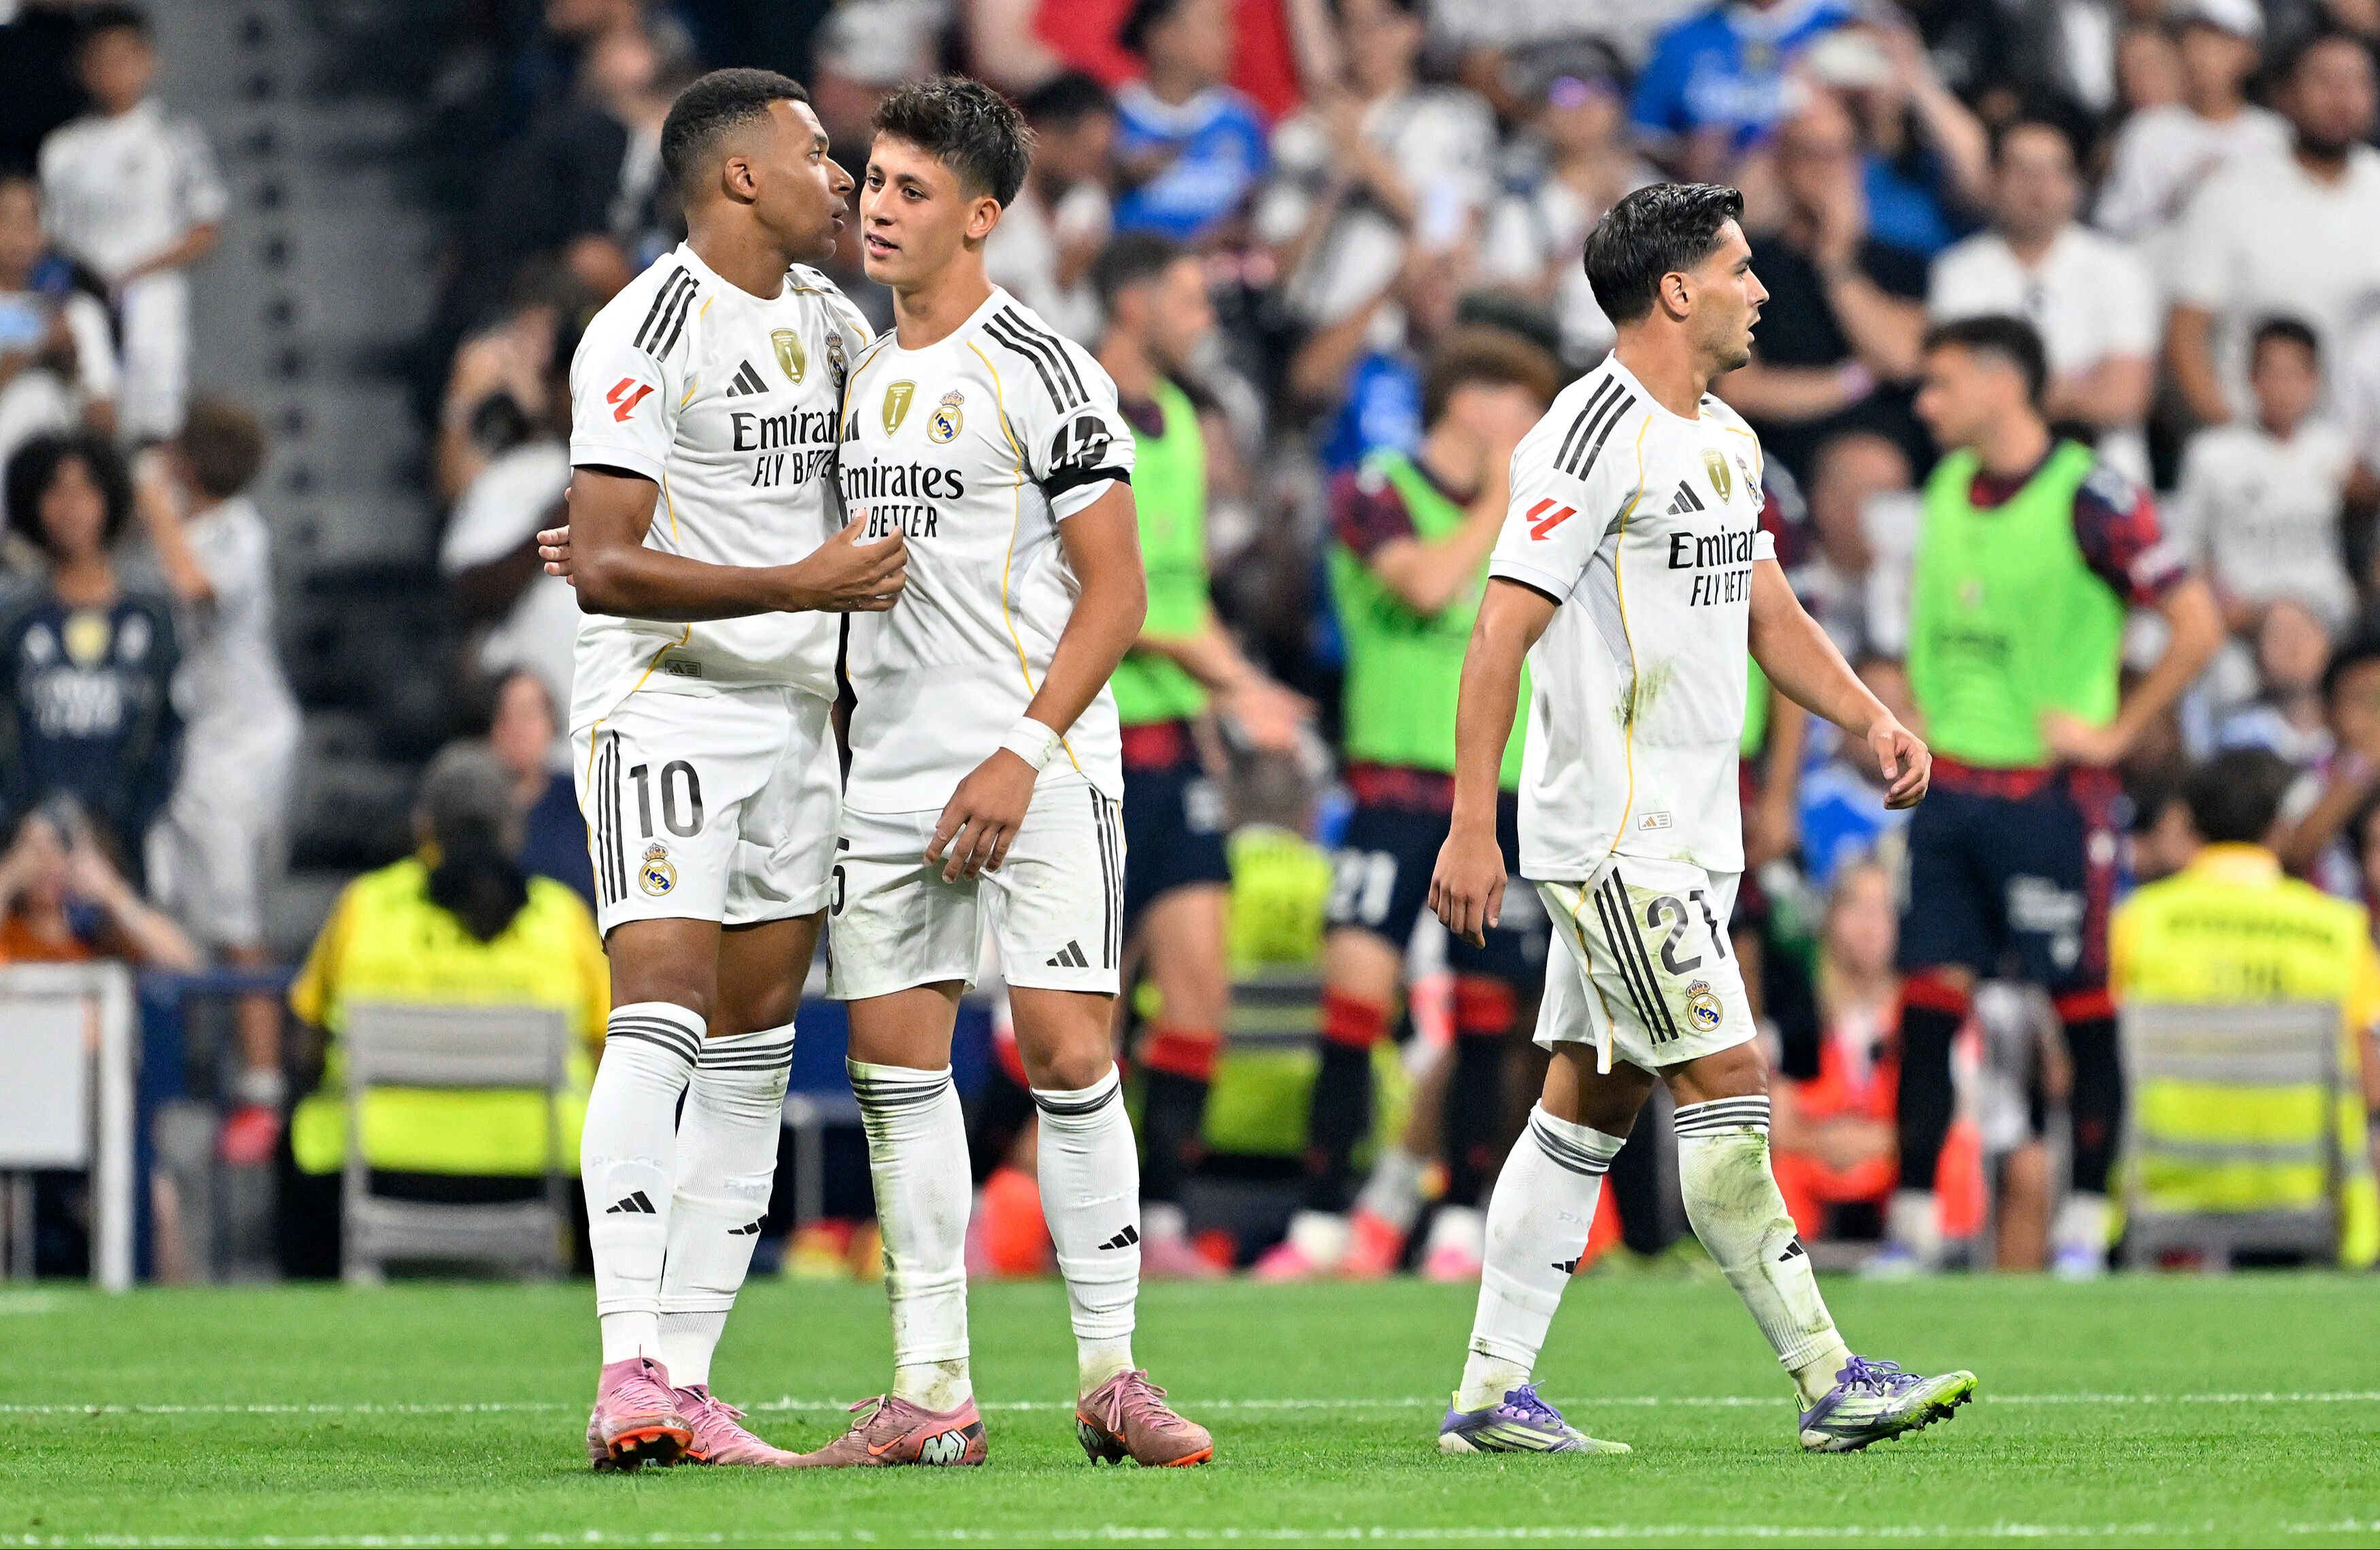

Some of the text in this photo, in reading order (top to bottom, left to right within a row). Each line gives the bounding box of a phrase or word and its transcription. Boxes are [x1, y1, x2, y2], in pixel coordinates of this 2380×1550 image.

[730, 405, 839, 451] Emirat
[751, 450, 836, 487] FLY BETTE
[868, 505, 937, 538] BETTER
[1669, 524, 1754, 569] Emirat
[1690, 573, 1720, 607] FLY
[628, 760, 704, 839] 10
[1647, 890, 1726, 976] 21
